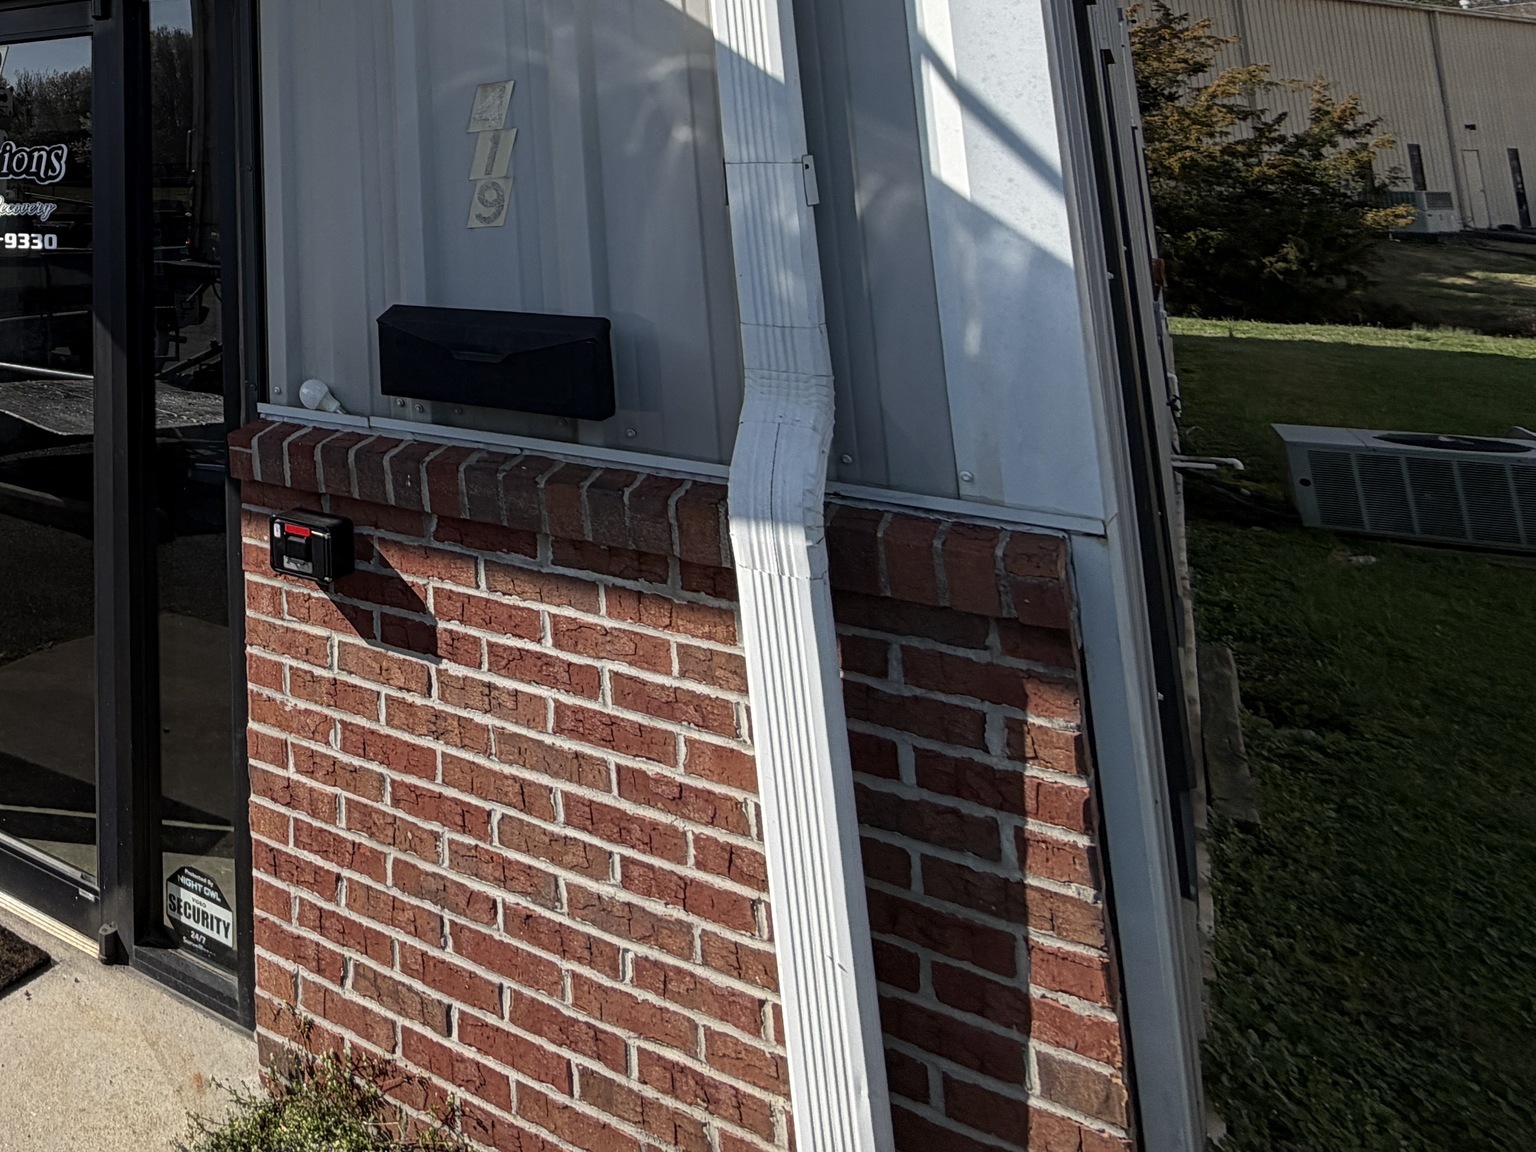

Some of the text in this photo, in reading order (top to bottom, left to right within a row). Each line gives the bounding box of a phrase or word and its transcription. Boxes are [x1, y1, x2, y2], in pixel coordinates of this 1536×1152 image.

[177, 875, 221, 902] NIGHT OWL
[191, 897, 207, 908] VIDEO
[168, 893, 231, 939] SECURITY
[190, 930, 207, 944] 24/7
